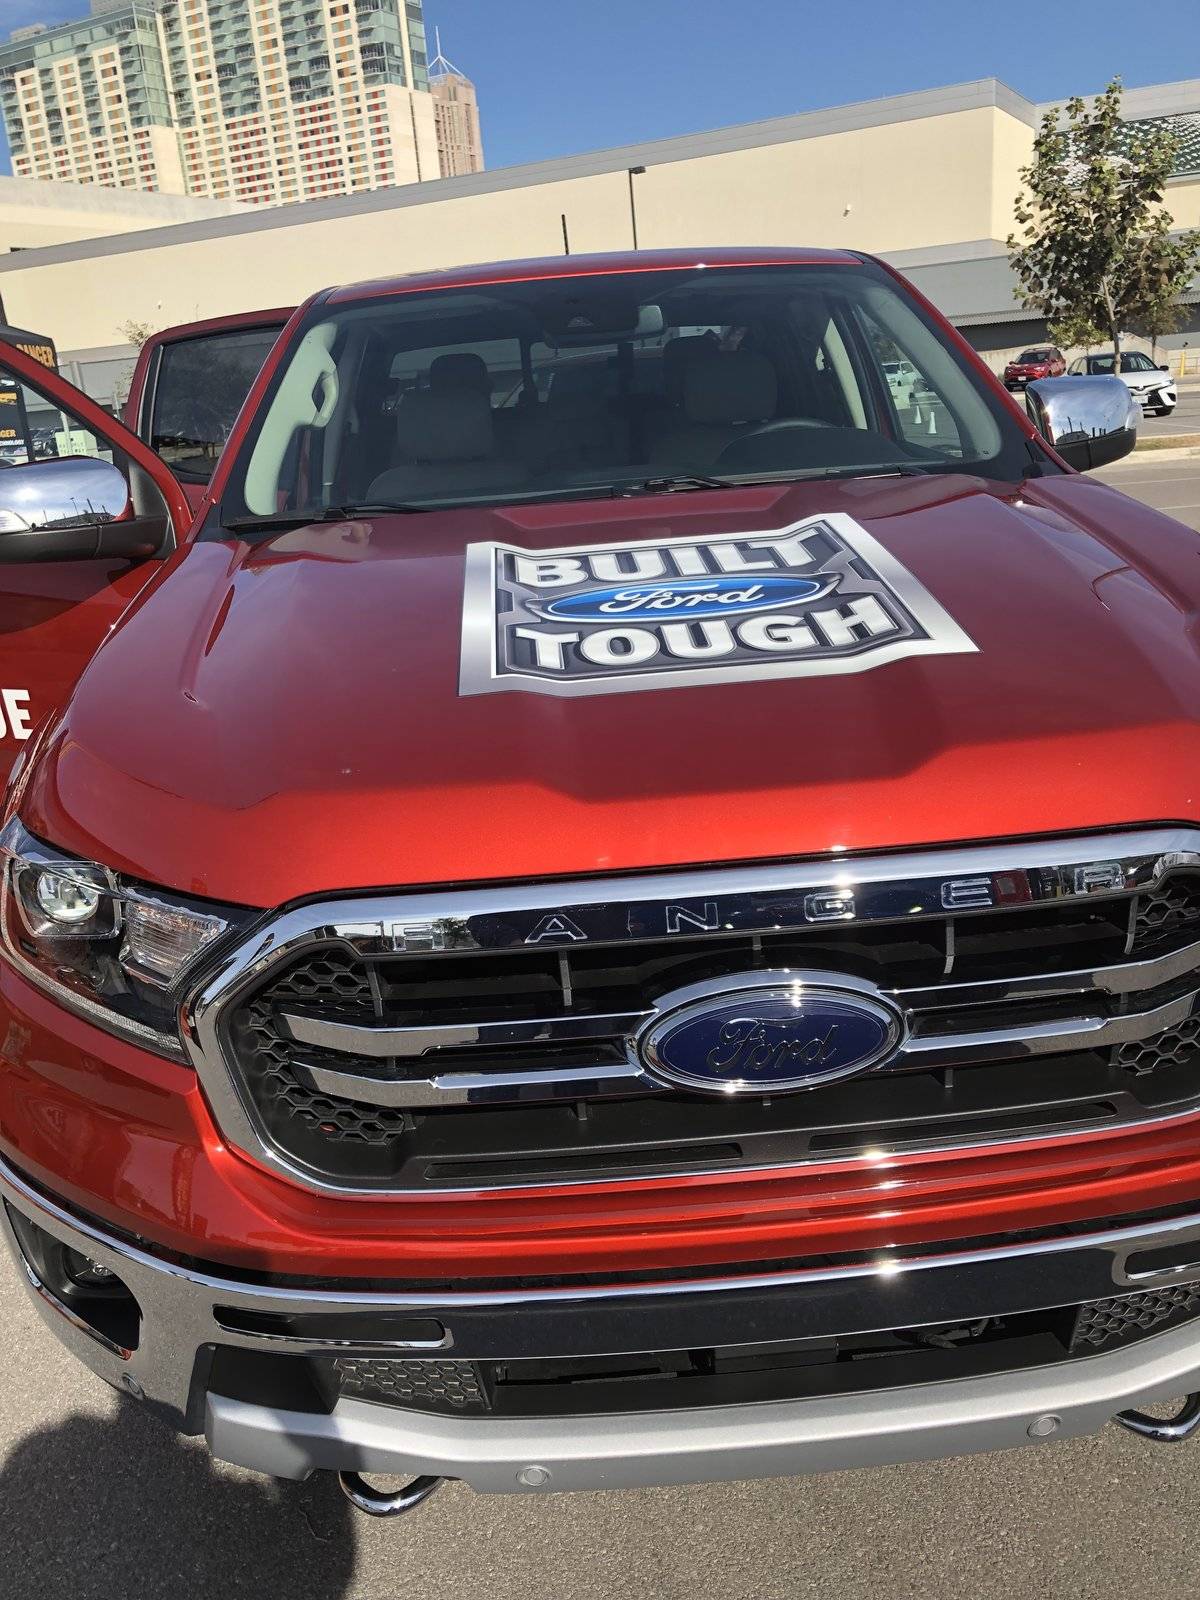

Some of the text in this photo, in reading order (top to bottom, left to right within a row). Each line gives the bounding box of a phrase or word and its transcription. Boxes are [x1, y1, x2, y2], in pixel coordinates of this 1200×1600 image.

[515, 527, 820, 588] BUILT
[599, 583, 765, 614] Ford
[515, 595, 898, 670] TOUGH
[392, 862, 1125, 951] RANGER
[706, 1015, 840, 1073] Ford
